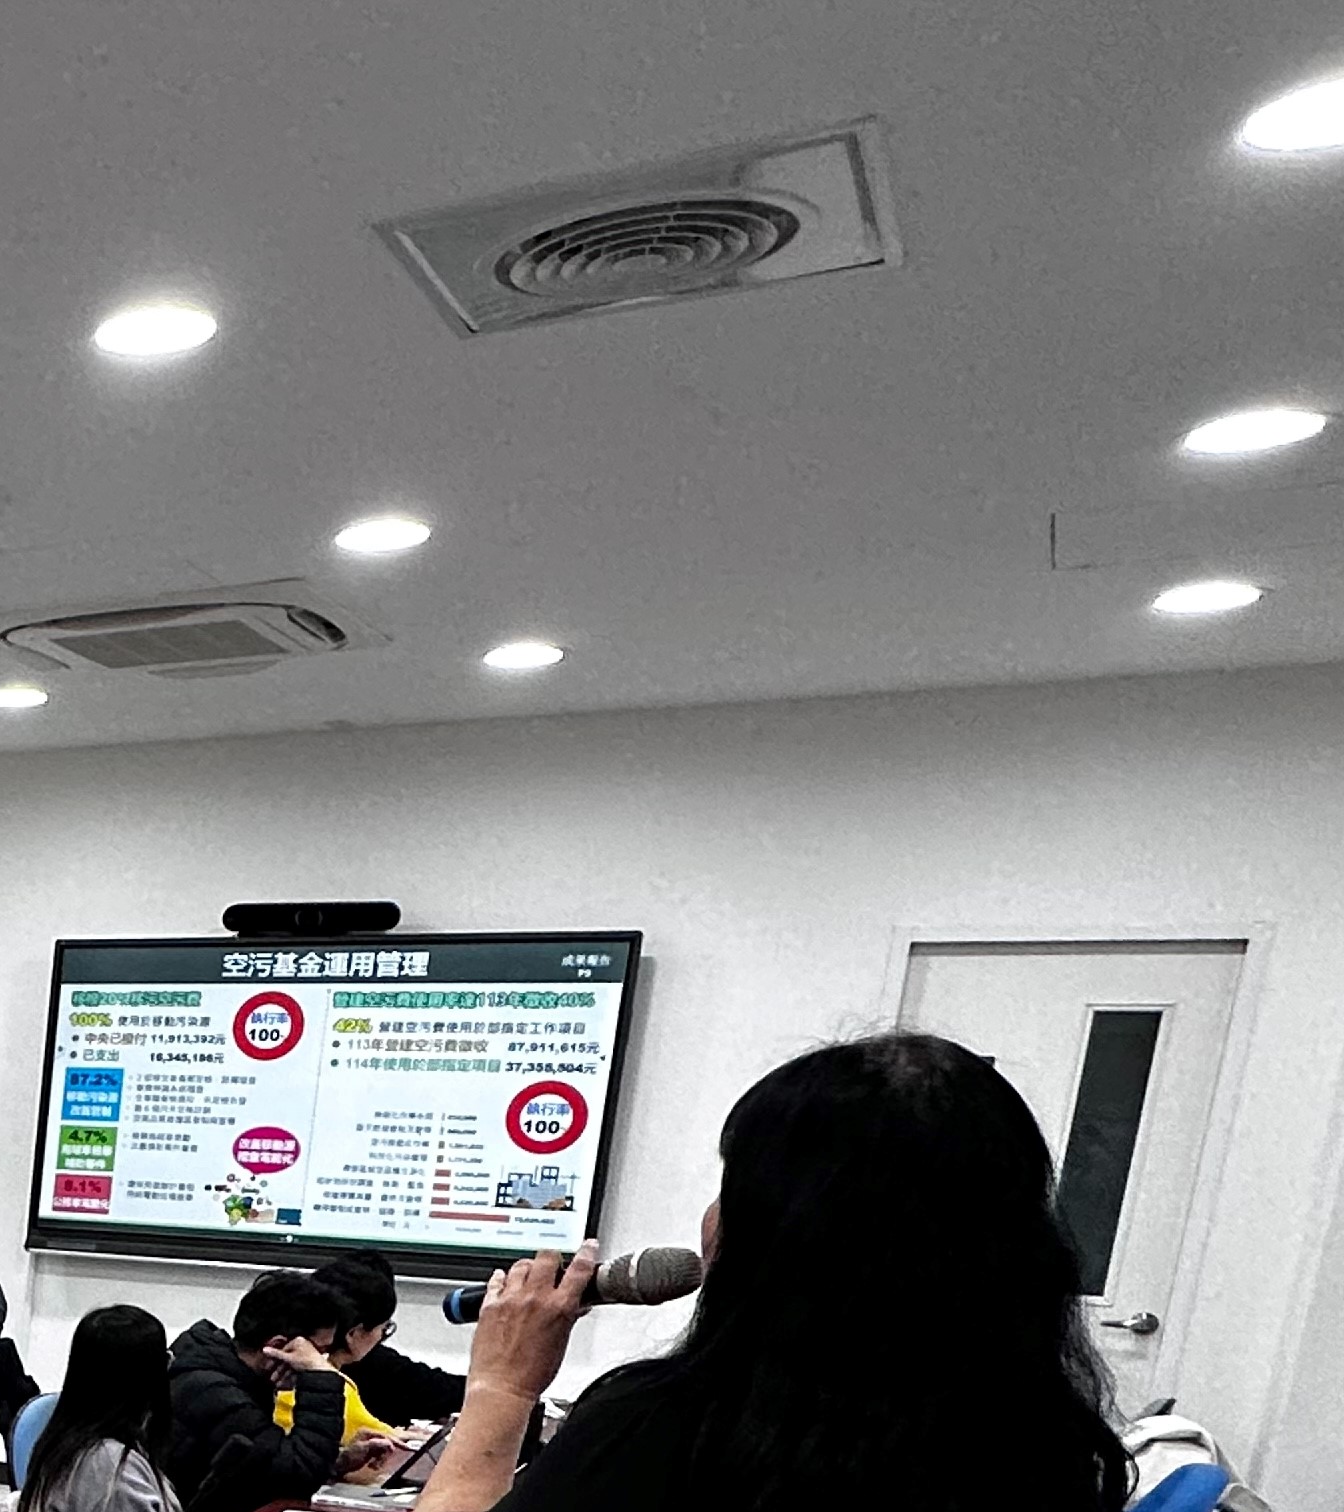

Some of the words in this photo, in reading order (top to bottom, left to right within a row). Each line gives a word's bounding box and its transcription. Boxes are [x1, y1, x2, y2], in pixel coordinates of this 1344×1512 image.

[221, 951, 430, 978] 空污基金運用管理
